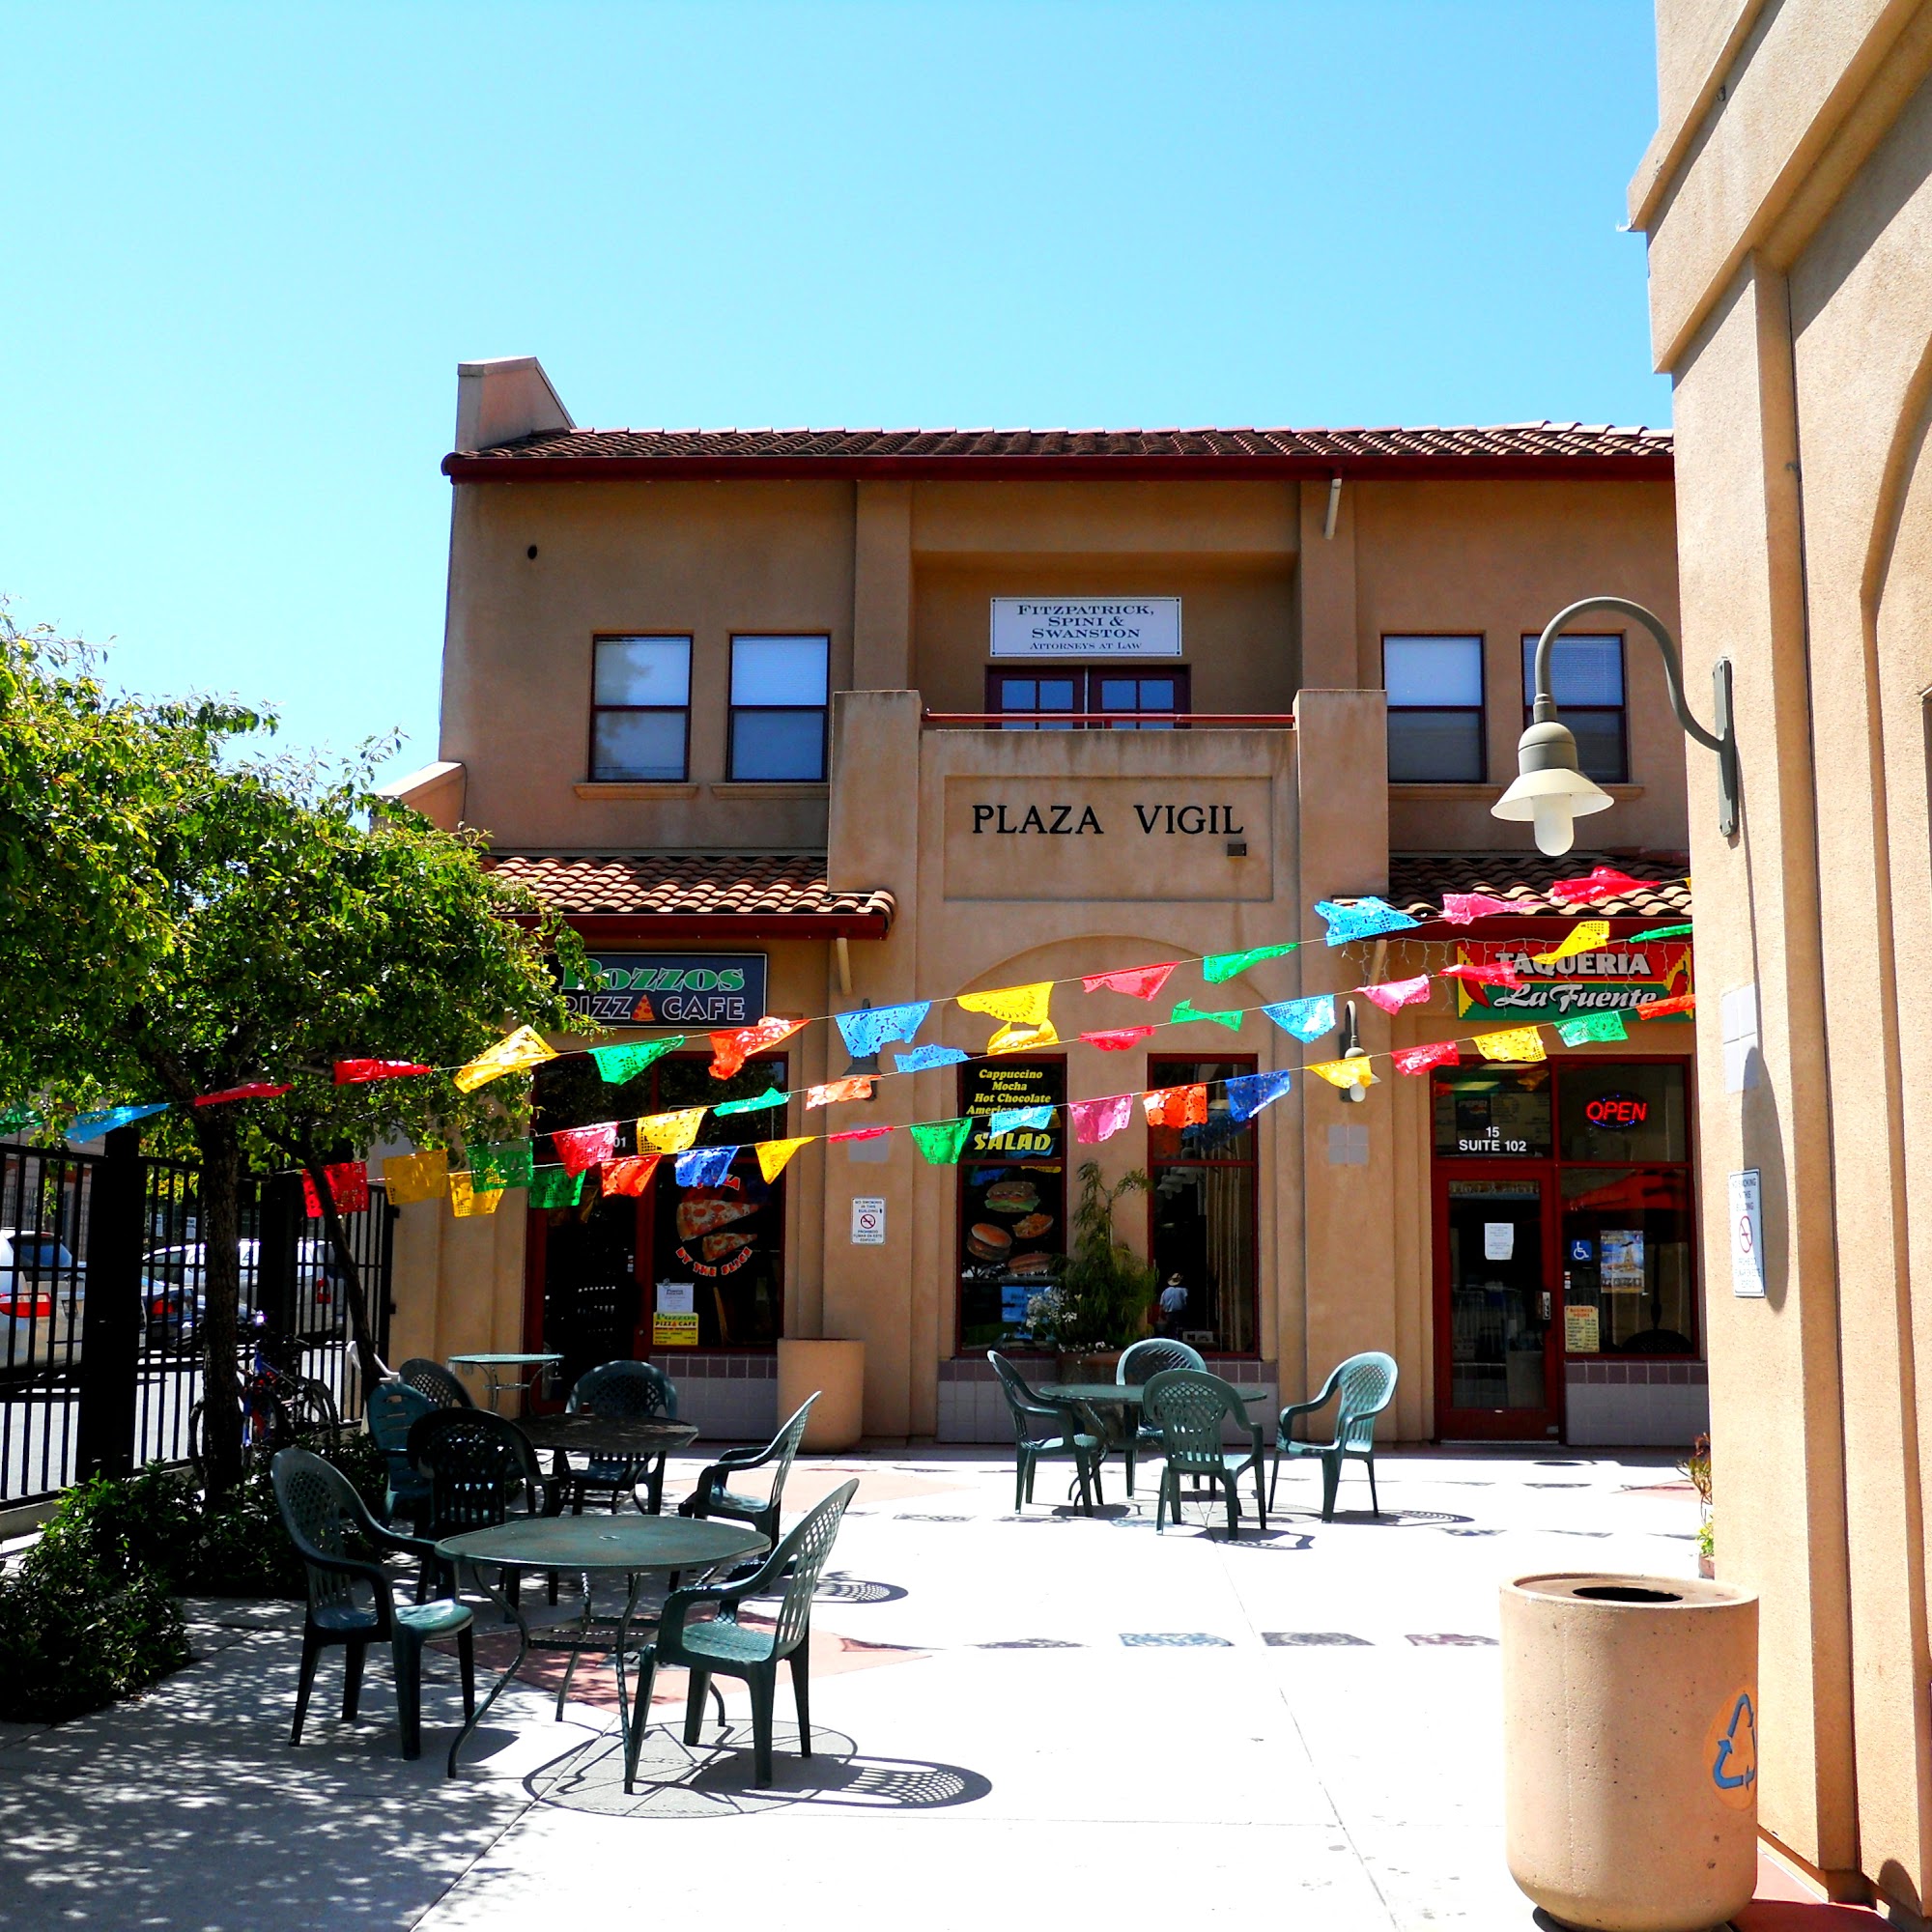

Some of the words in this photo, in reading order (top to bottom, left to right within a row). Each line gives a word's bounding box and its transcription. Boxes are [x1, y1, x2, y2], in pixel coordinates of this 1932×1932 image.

[1109, 615, 1124, 627] &
[1032, 628, 1141, 639] SWANSTON
[972, 805, 1104, 835] PLAZA
[1133, 805, 1245, 835] VIGIL
[1492, 982, 1548, 1007] La
[1548, 983, 1658, 1013] Fuente
[661, 995, 746, 1021] CAFE
[979, 1068, 1044, 1080] Cappuccino
[991, 1081, 1028, 1091] Mocha
[974, 1093, 996, 1103] Hot
[997, 1093, 1052, 1103] Chocolate
[1586, 1100, 1648, 1122] OPEN
[1485, 1125, 1500, 1138] 15
[974, 1132, 1052, 1151] SALAD
[1459, 1139, 1500, 1151] SUITE
[1504, 1140, 1527, 1151] 102
